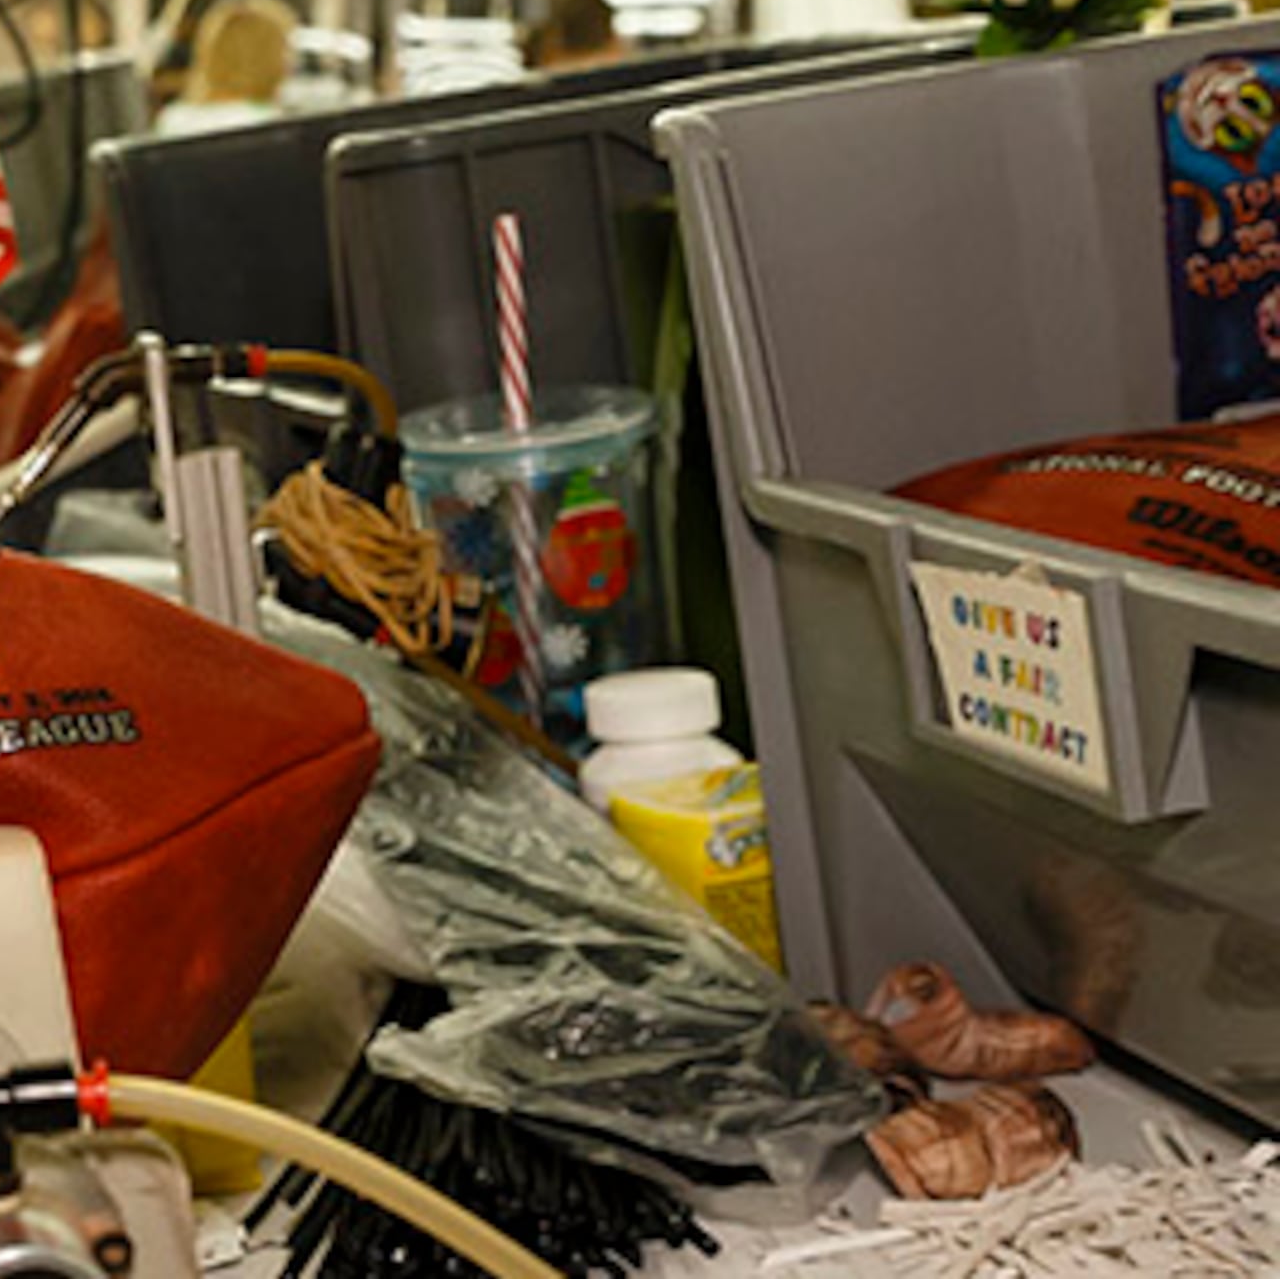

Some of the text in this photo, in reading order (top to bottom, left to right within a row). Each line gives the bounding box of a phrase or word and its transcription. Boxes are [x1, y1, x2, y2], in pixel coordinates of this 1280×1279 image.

[951, 593, 1061, 650] GIVE US
[972, 649, 1062, 707] A FAIR
[958, 691, 1088, 765] CONTRACT
